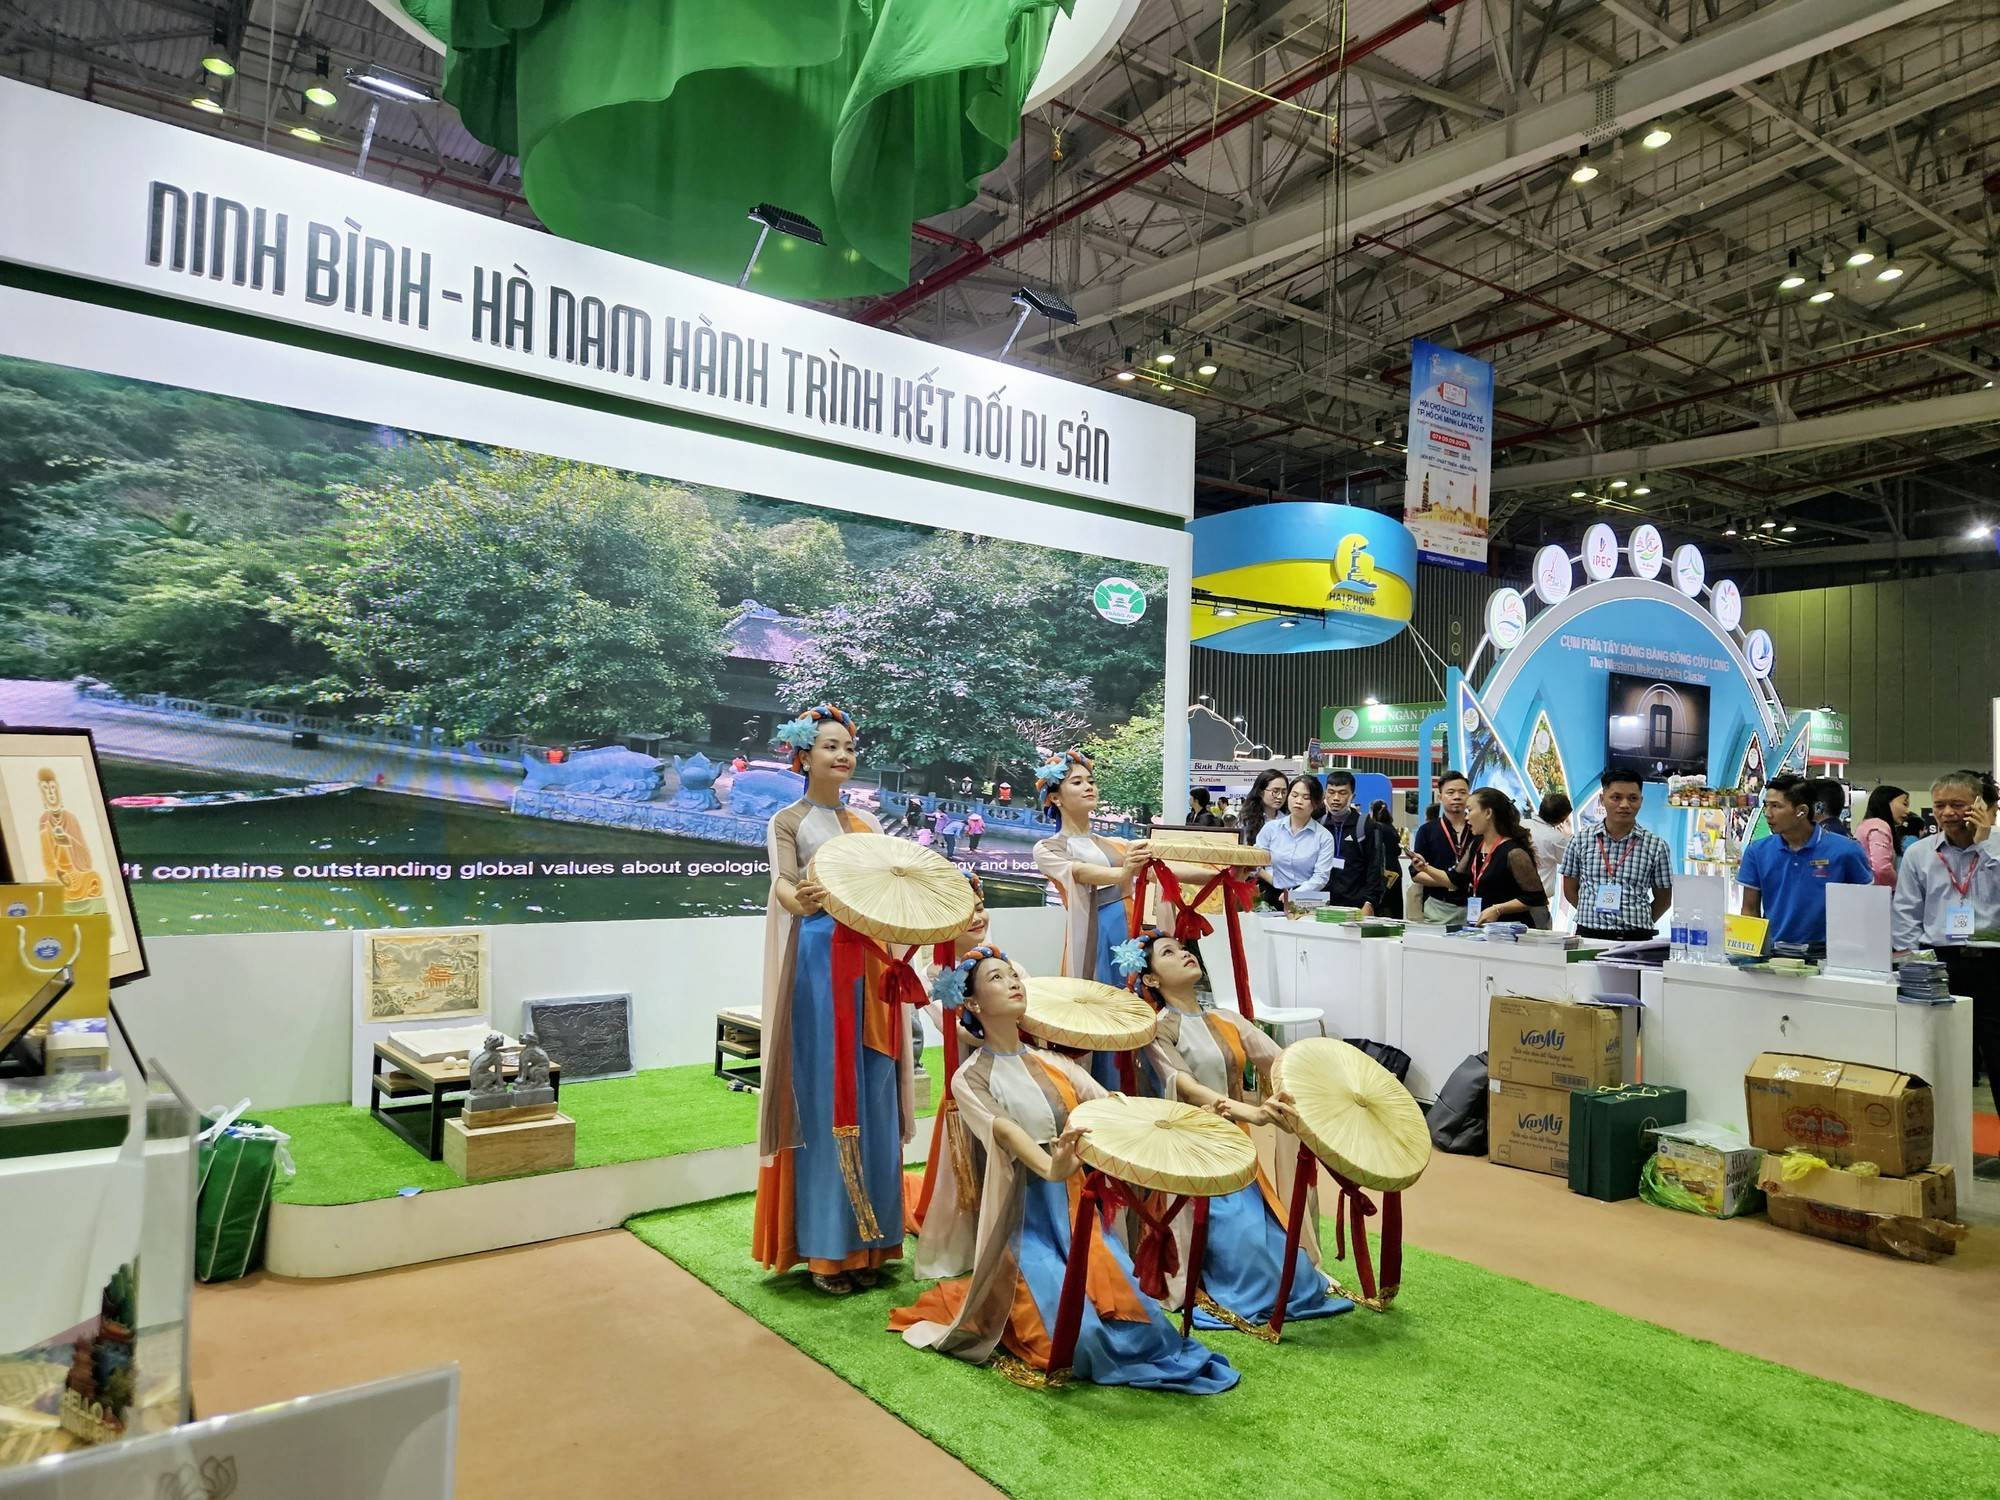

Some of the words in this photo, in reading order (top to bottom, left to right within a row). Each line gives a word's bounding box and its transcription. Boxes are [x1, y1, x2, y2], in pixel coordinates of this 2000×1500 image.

[145, 180, 288, 296] NINH
[305, 216, 431, 330] BÌNH
[472, 263, 534, 354] HÀ
[548, 285, 652, 382] NAM
[664, 313, 768, 408] HÀNH
[782, 348, 883, 435] TRÌNH
[893, 367, 954, 449] KẾT
[964, 385, 1012, 463] NỐI
[1021, 410, 1046, 471] DI
[1057, 411, 1109, 484] SẢN
[1347, 595, 1375, 606] PHONG
[1589, 656, 1603, 669] The
[1388, 724, 1409, 733] VAST
[152, 862, 283, 880] contains
[293, 862, 452, 880] outstanding
[460, 861, 534, 880] global
[540, 859, 614, 876] values
[621, 860, 681, 875] about
[981, 859, 1008, 870] and
[1727, 939, 1756, 951] TRAVEL
